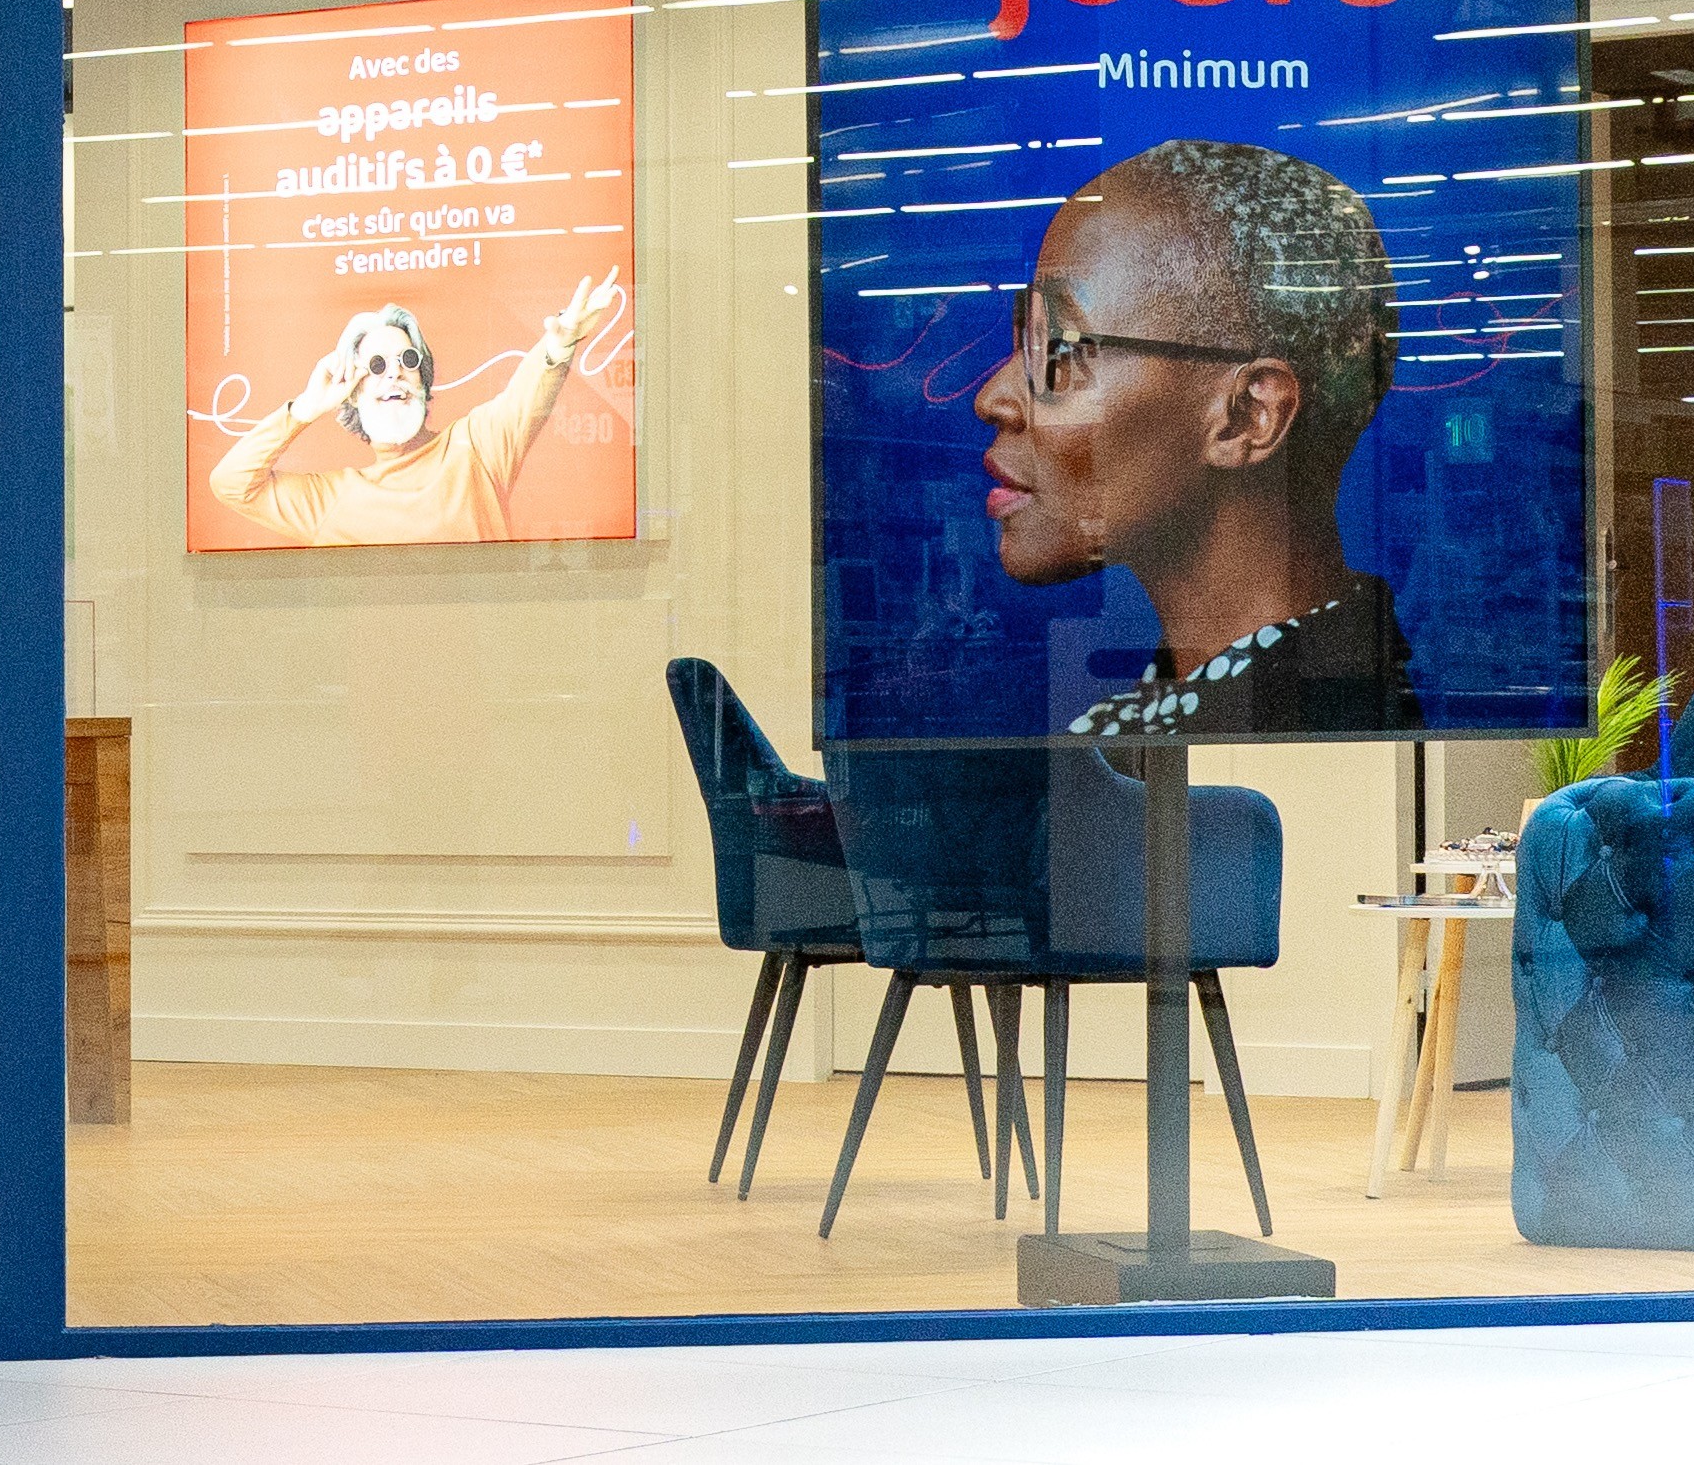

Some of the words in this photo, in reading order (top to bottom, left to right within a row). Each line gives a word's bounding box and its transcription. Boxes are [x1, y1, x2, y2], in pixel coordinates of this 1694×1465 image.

[348, 52, 410, 81] Avec
[415, 47, 461, 76] des
[1098, 50, 1310, 89] Minimum
[317, 84, 499, 142] appareils
[275, 149, 424, 197] auditifs
[435, 145, 459, 185] à
[467, 145, 493, 183] 0
[302, 208, 359, 239] c'est
[364, 206, 404, 236] sûr
[409, 204, 479, 237] qu'on
[484, 204, 516, 228] va
[334, 244, 469, 276] s'entendre
